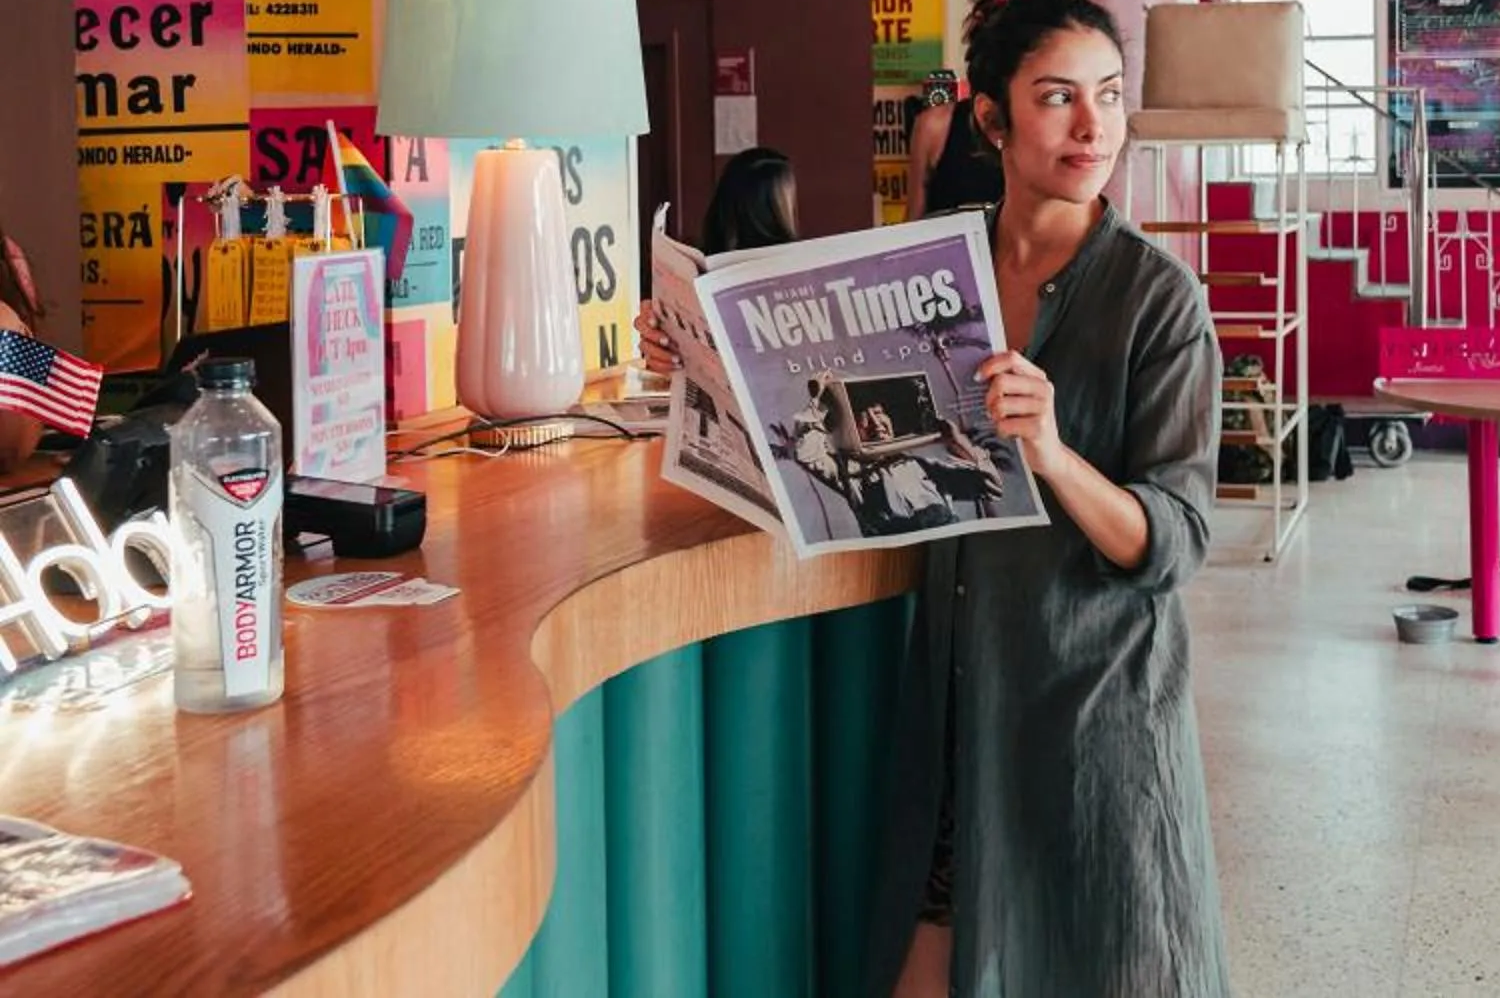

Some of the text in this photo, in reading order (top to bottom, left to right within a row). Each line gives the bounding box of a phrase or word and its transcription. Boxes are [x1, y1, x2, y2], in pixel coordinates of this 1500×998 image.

[256, 124, 429, 183] SATA
[737, 268, 964, 353] New Times
[772, 283, 817, 302] MIAMI
[787, 348, 866, 375] blind
[234, 519, 258, 664] BODYARMOR
